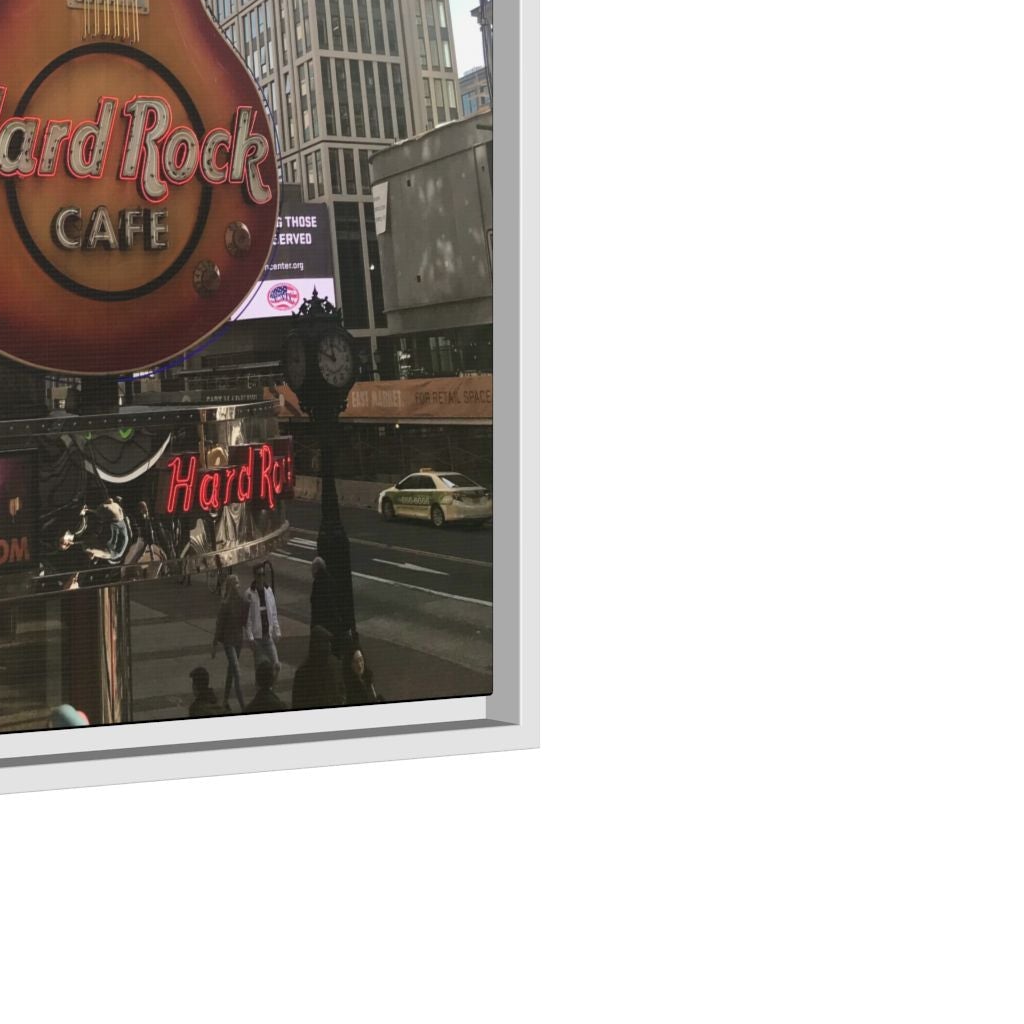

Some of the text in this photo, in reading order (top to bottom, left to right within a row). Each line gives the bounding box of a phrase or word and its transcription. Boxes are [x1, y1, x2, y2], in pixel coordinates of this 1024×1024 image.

[120, 95, 273, 205] Rock
[54, 206, 169, 250] CAFE
[285, 216, 317, 227] THOSE
[432, 391, 461, 404] RETAIL
[464, 390, 491, 403] SPACE
[167, 446, 254, 512] Hard
